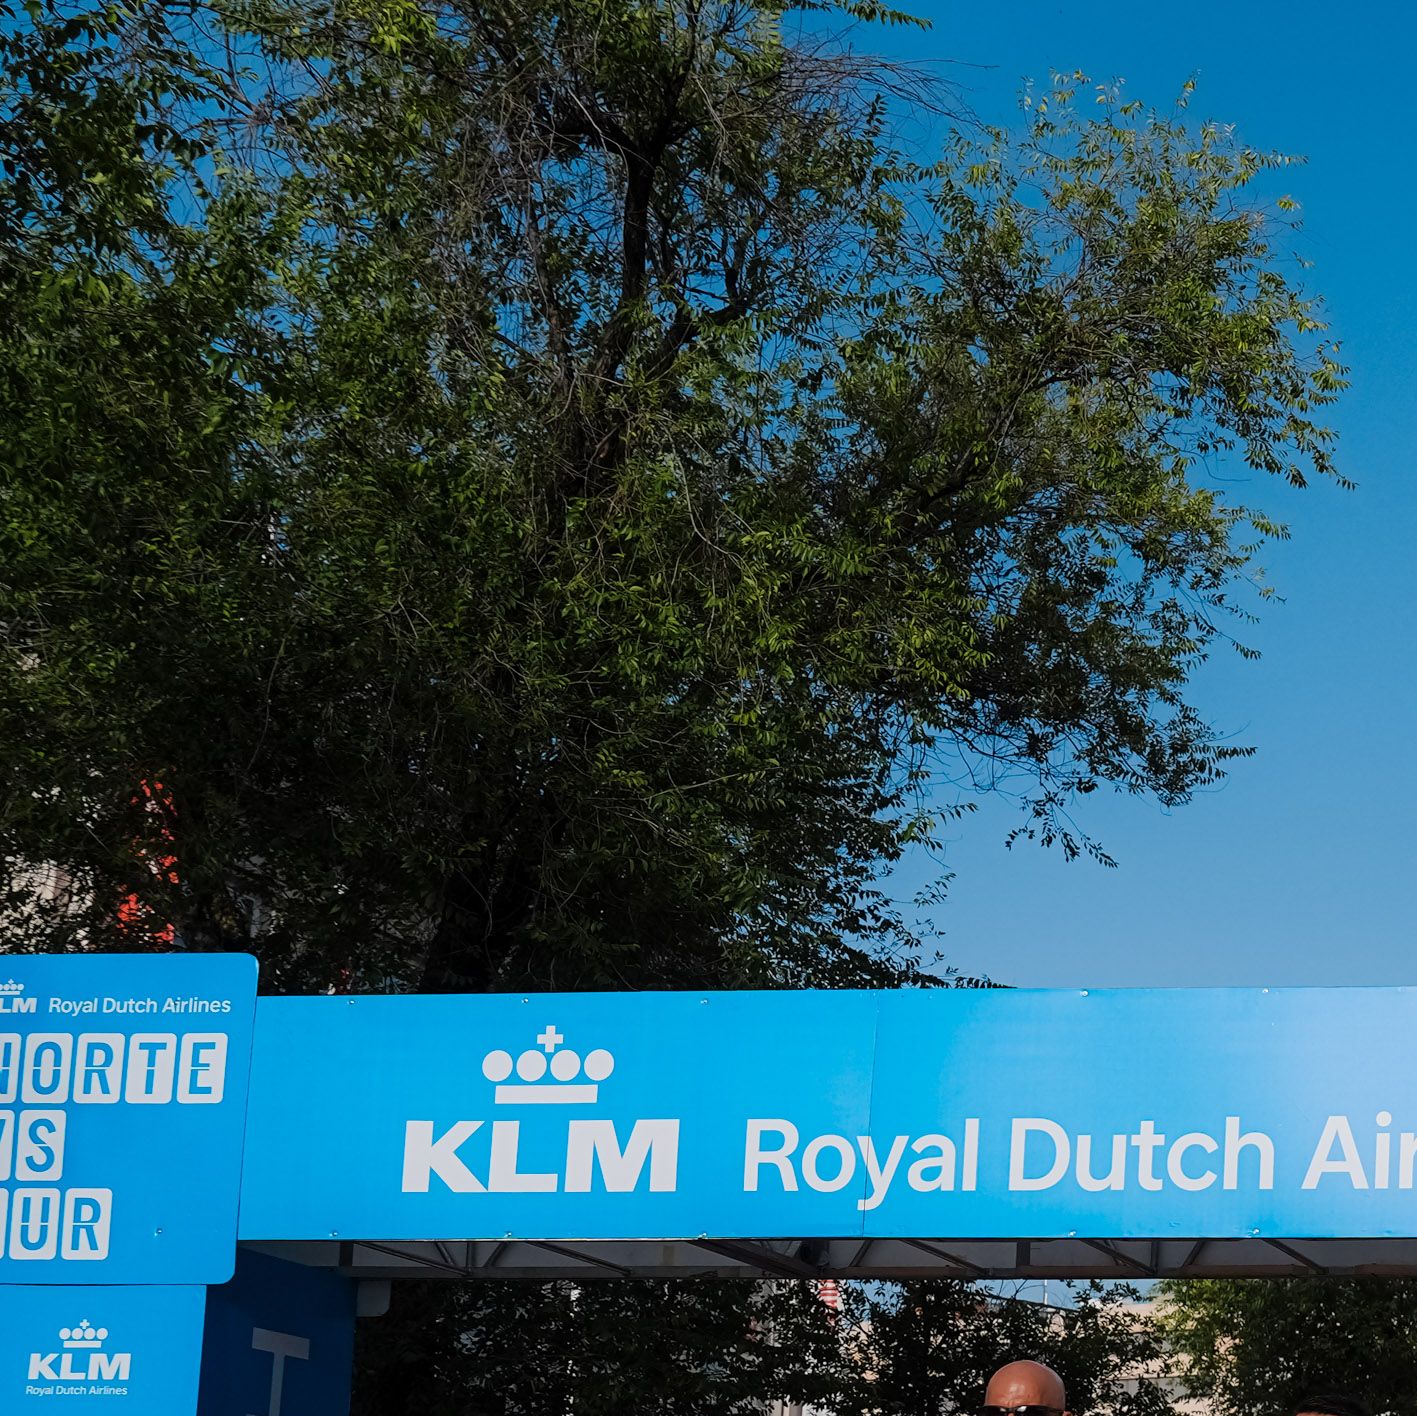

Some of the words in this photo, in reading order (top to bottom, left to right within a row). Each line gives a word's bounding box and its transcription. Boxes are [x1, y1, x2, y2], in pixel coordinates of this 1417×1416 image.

[0, 997, 38, 1013] LM
[49, 997, 98, 1017] Royal
[103, 997, 158, 1013] Dutch
[162, 997, 231, 1013] Airlines
[0, 1118, 56, 1173] S
[401, 1118, 681, 1193] KLM
[743, 1116, 979, 1212] Royal
[1008, 1115, 1274, 1191] Dutch
[20, 1196, 101, 1251] UR
[28, 1352, 132, 1381] KLM
[26, 1385, 54, 1397] Royal
[56, 1385, 87, 1395] Dutch
[88, 1385, 128, 1396] Airlines
